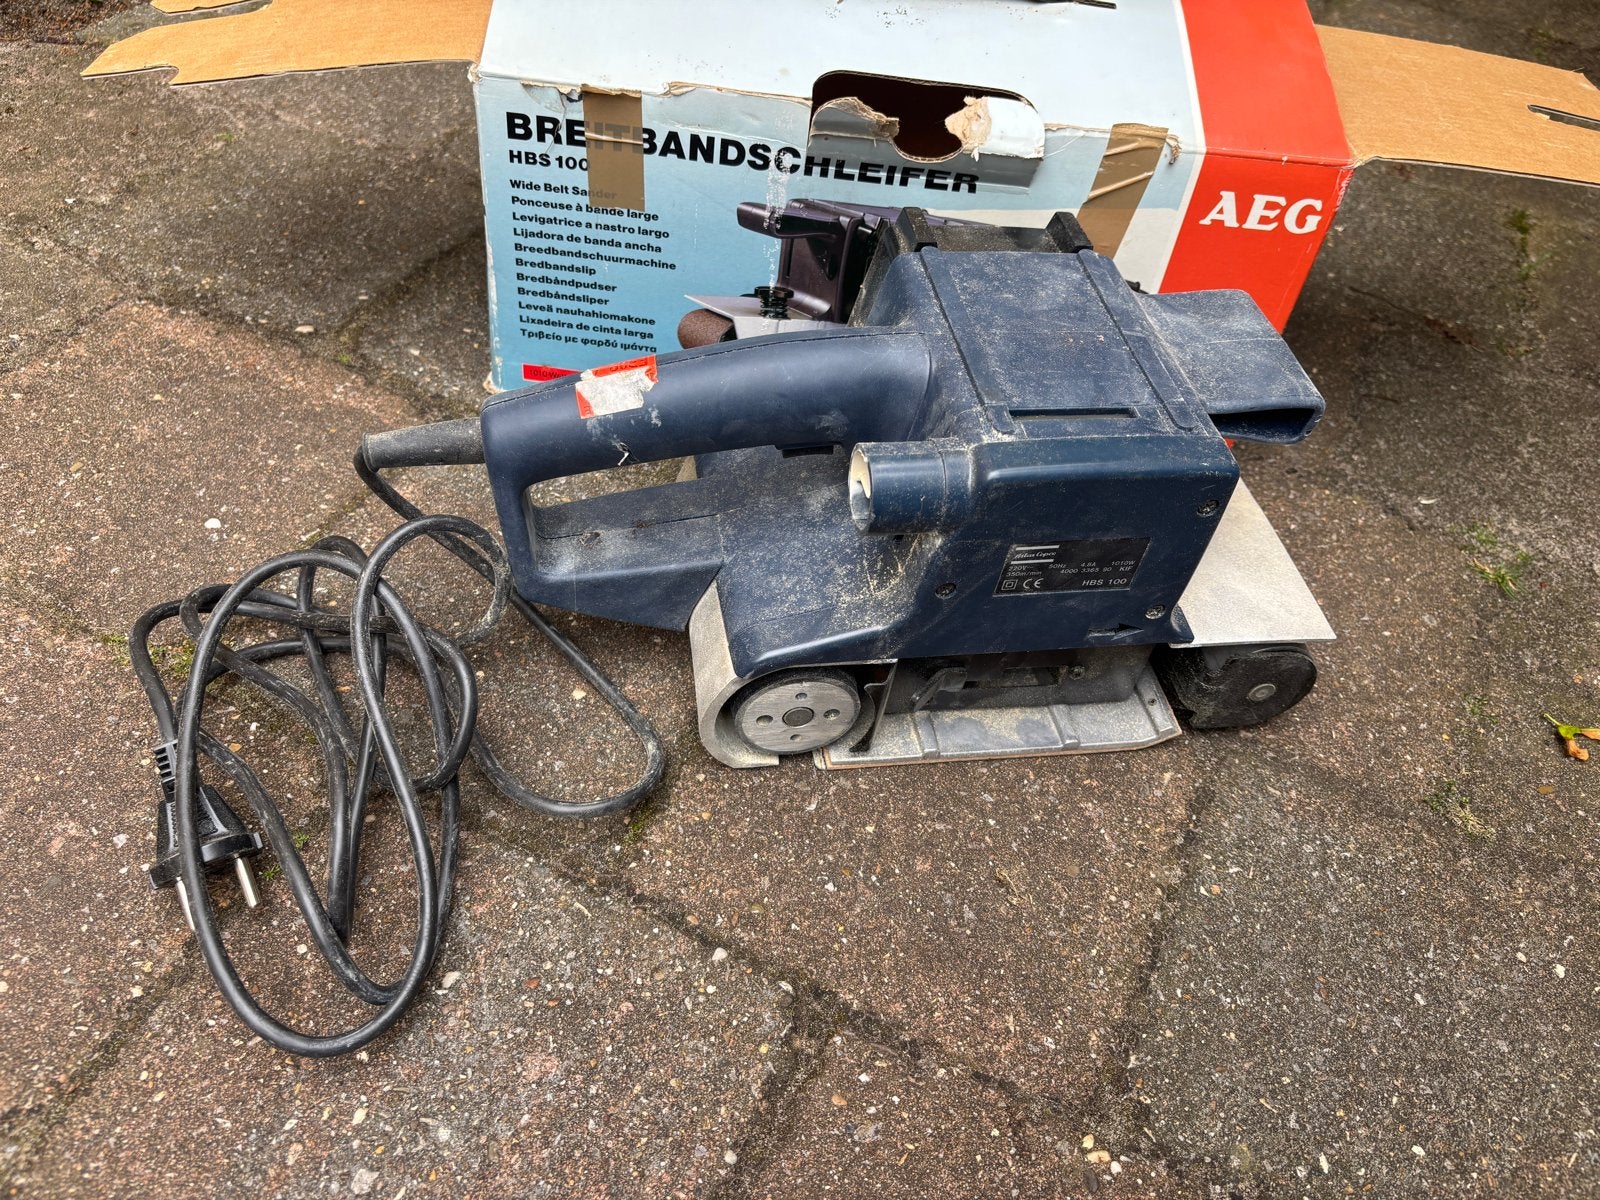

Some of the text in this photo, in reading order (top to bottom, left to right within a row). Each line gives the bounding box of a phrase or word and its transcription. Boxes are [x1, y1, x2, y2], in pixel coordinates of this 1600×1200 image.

[508, 149, 589, 172] HBS 100
[509, 179, 541, 192] Wide
[543, 182, 570, 195] Belt
[511, 195, 660, 222] Ponceuse à bande large
[1198, 190, 1323, 235] AEG
[512, 211, 670, 239] Levigatrice a nastro largo
[513, 227, 662, 253] Lijadora de banda ancha
[514, 242, 677, 271] Breedbandschuurmachine
[515, 257, 597, 276] Bredbandslip
[516, 272, 618, 293] Bredbåndpudser
[517, 287, 610, 306] Bredbåndsliper
[518, 300, 656, 326] Leveä nauhahiomakone
[519, 314, 654, 341] Lixadeira de cinta larga
